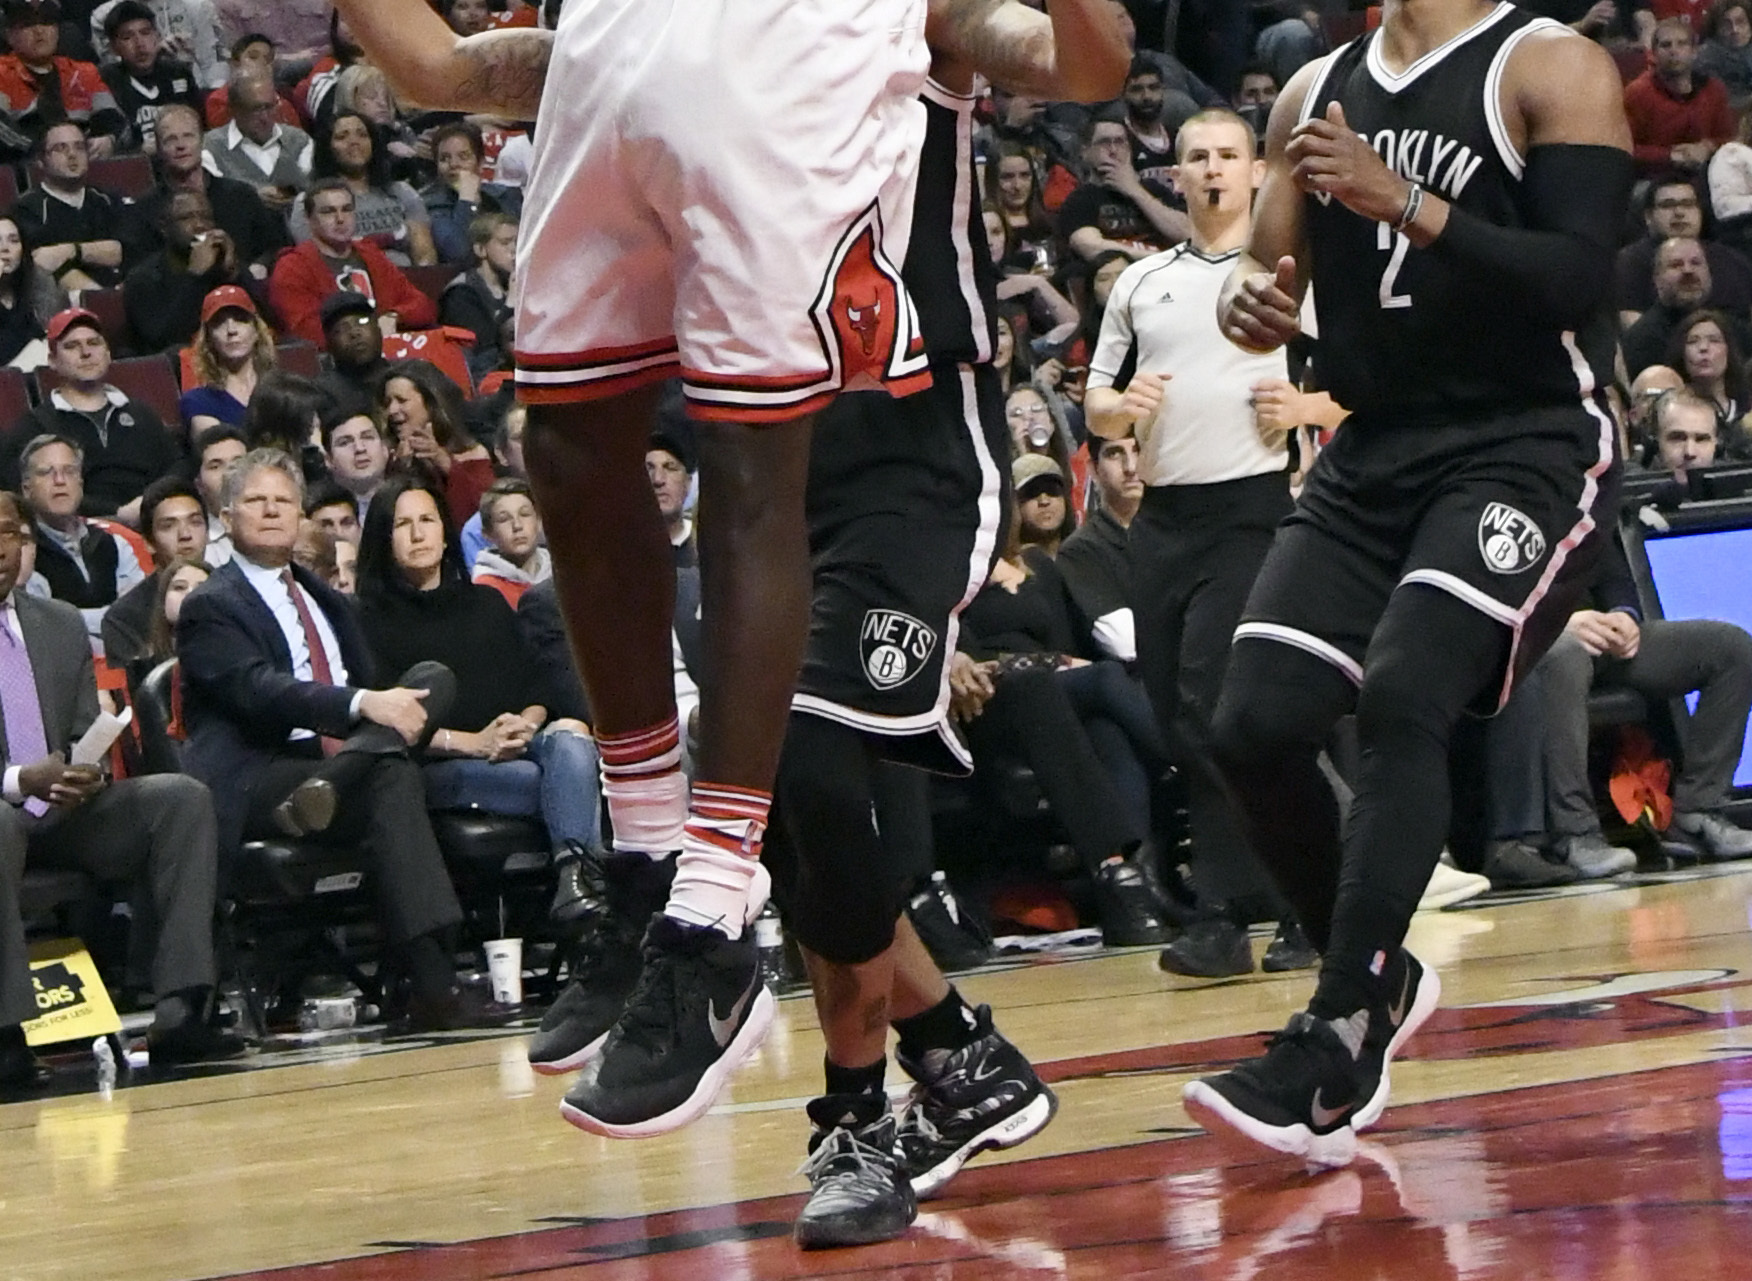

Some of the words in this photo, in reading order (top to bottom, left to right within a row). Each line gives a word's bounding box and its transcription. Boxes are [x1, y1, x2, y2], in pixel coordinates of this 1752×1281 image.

[1340, 128, 1483, 203] OKLYN
[1376, 220, 1413, 309] 2
[1483, 506, 1542, 561] NETS
[863, 613, 931, 660] NETS
[879, 650, 896, 678] B
